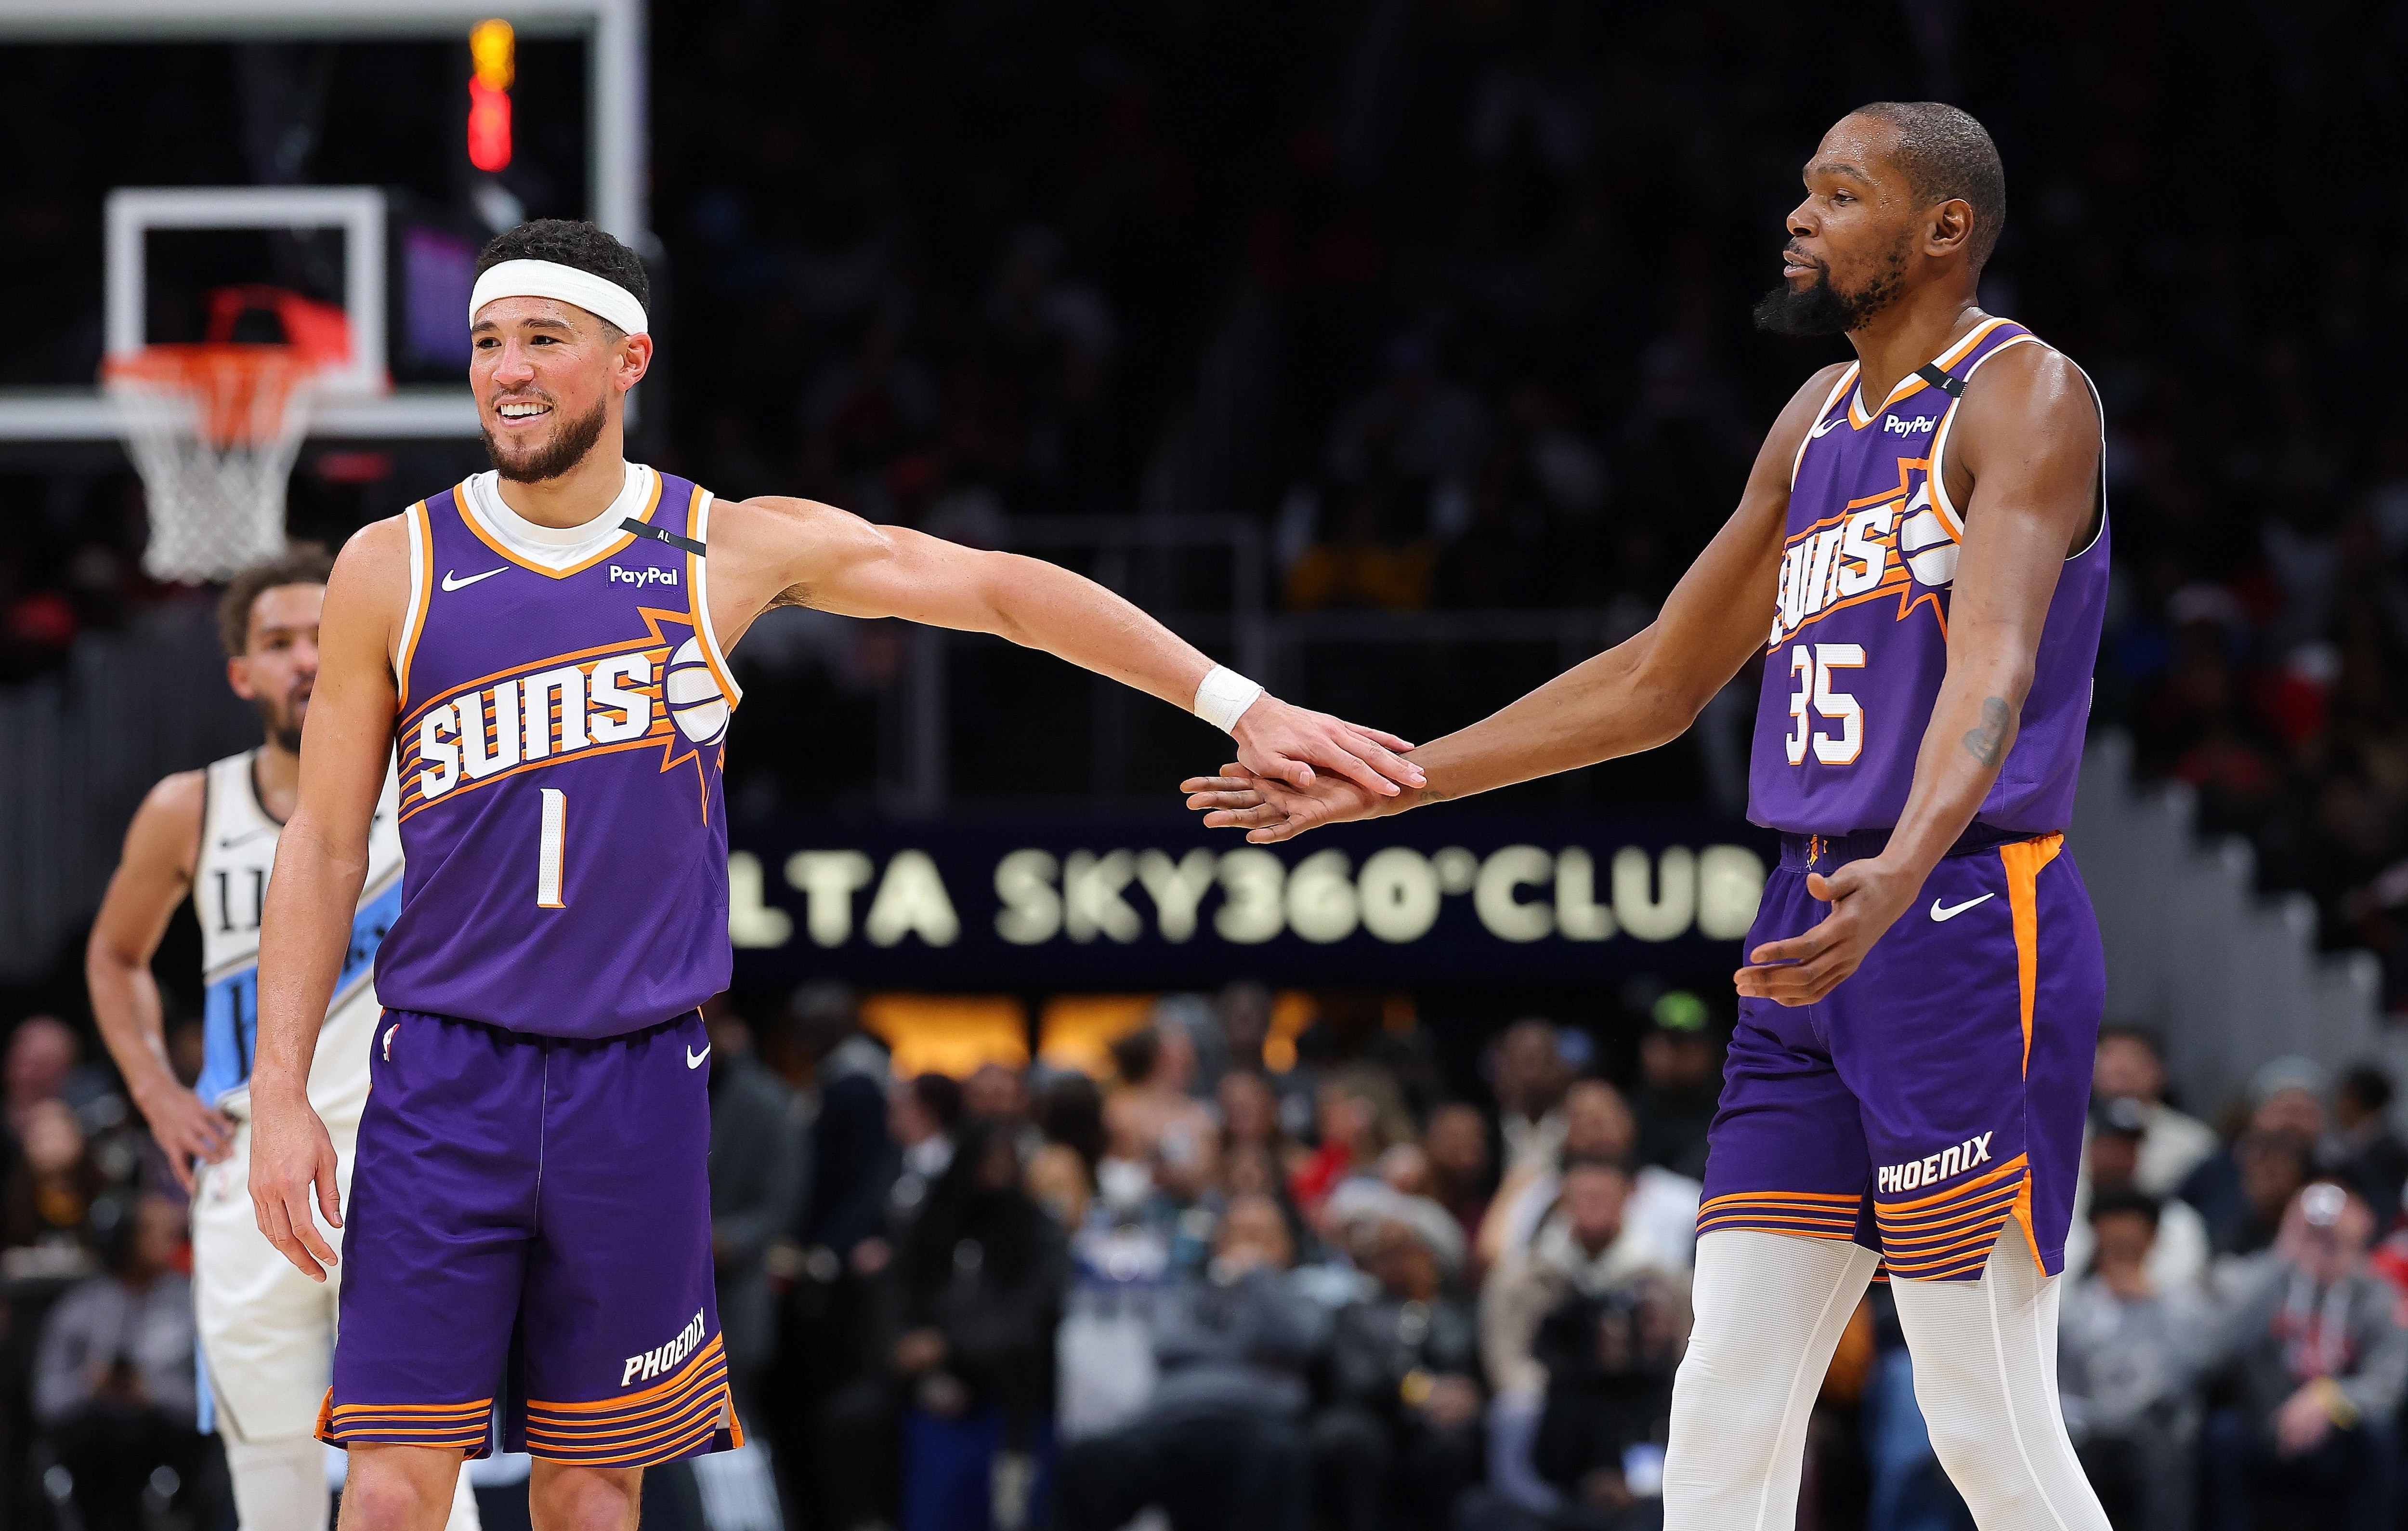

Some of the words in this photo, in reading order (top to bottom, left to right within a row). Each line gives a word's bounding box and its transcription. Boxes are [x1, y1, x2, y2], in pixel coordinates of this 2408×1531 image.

[1884, 414, 1937, 438] PayPal
[657, 529, 670, 543] AL
[610, 565, 678, 588] PayPal
[419, 653, 652, 800] SUNS
[1786, 643, 1867, 766] 35
[537, 788, 566, 909] 1
[212, 867, 265, 932] 11
[1474, 844, 1764, 943] CLUB
[1879, 1131, 1993, 1194] PHOENIX
[621, 1307, 706, 1387] PHOENIX
